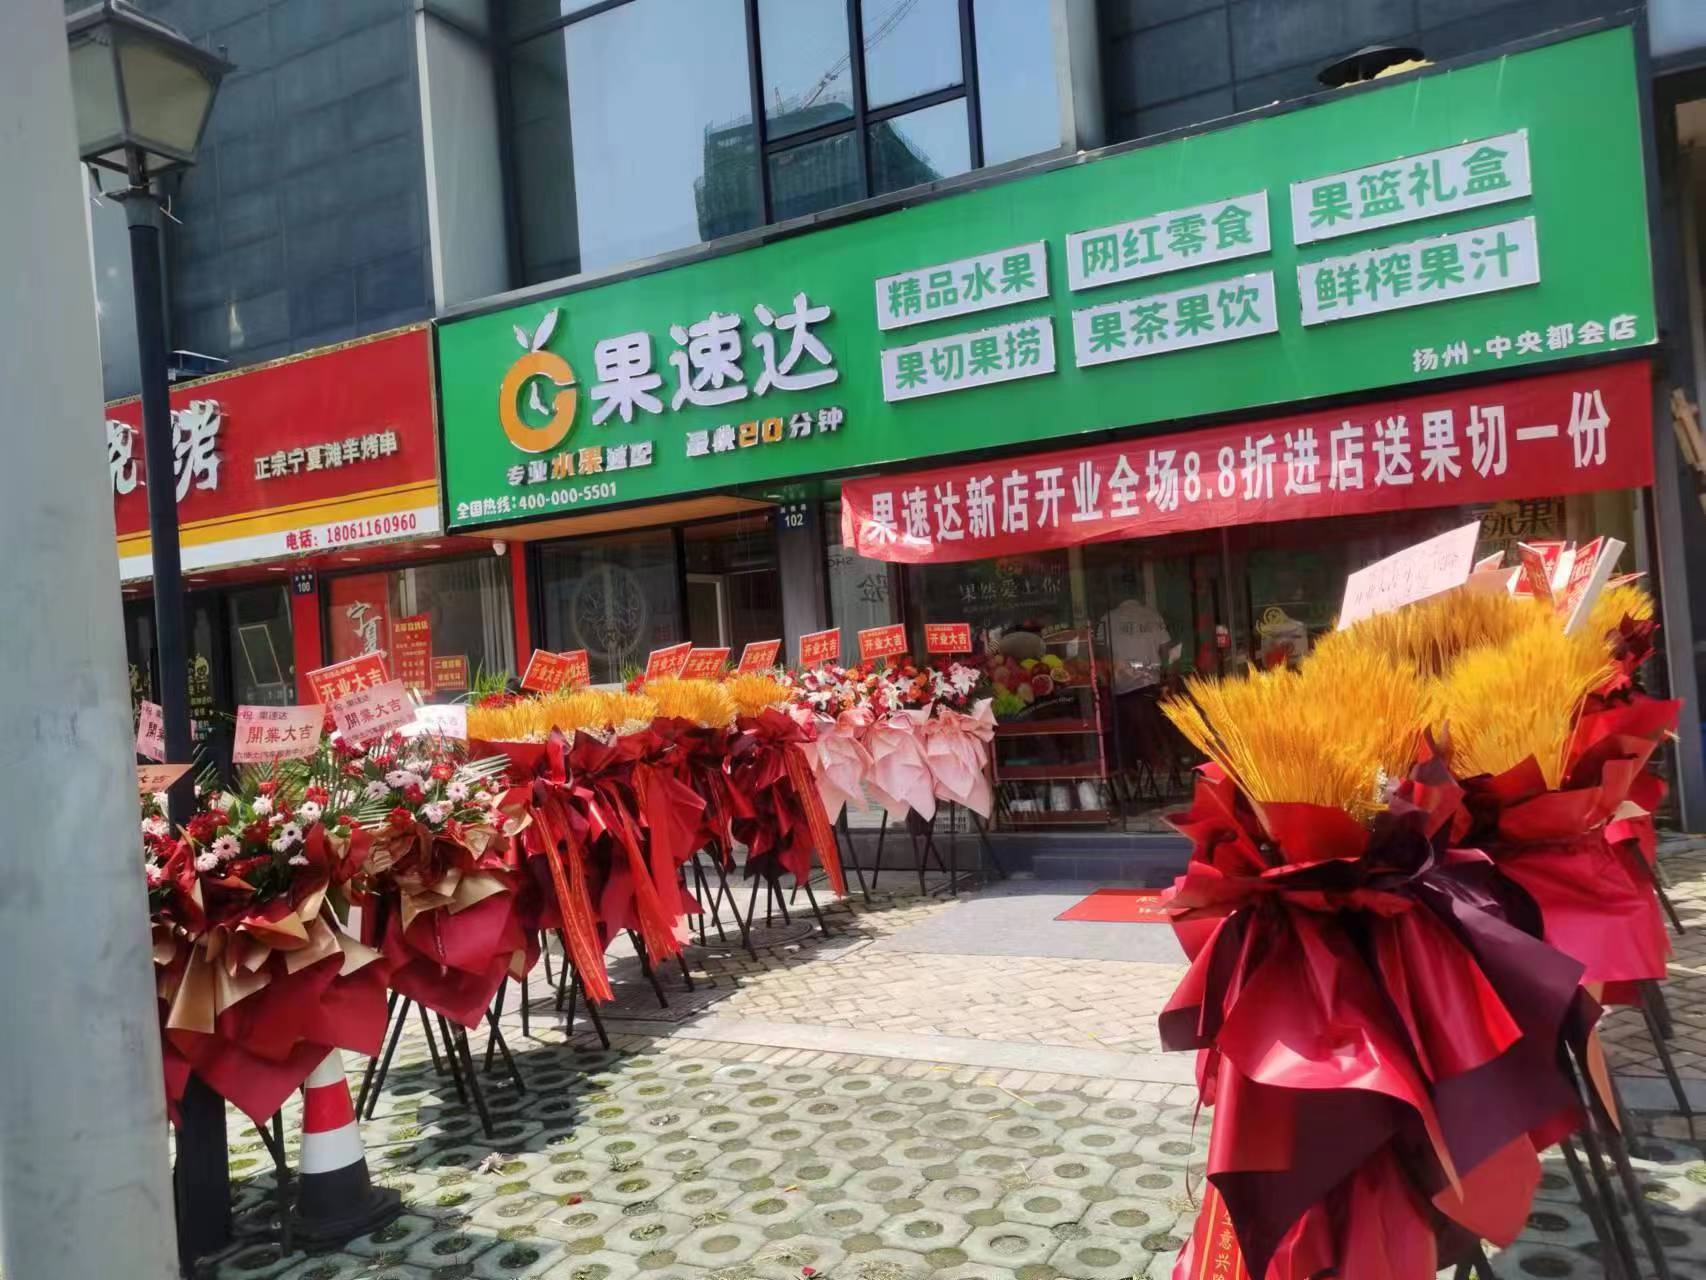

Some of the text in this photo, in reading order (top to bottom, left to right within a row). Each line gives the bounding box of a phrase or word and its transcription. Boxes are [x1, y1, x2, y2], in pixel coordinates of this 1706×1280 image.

[1309, 146, 1512, 228] 果篮礼盒
[1081, 204, 1253, 278] 网红零食
[1314, 231, 1519, 310] 鲜榨果汁
[888, 252, 1037, 318] 精品水果
[1088, 285, 1261, 353] 果茶果饮
[591, 291, 839, 425] 果速达
[895, 326, 1041, 389] 果切果捞
[867, 389, 1611, 546] 果速达新店开业全场8.8折进店送果切一份
[784, 513, 804, 527] 102
[930, 633, 967, 645] 开业大吉
[246, 724, 313, 744] 開業大吉
